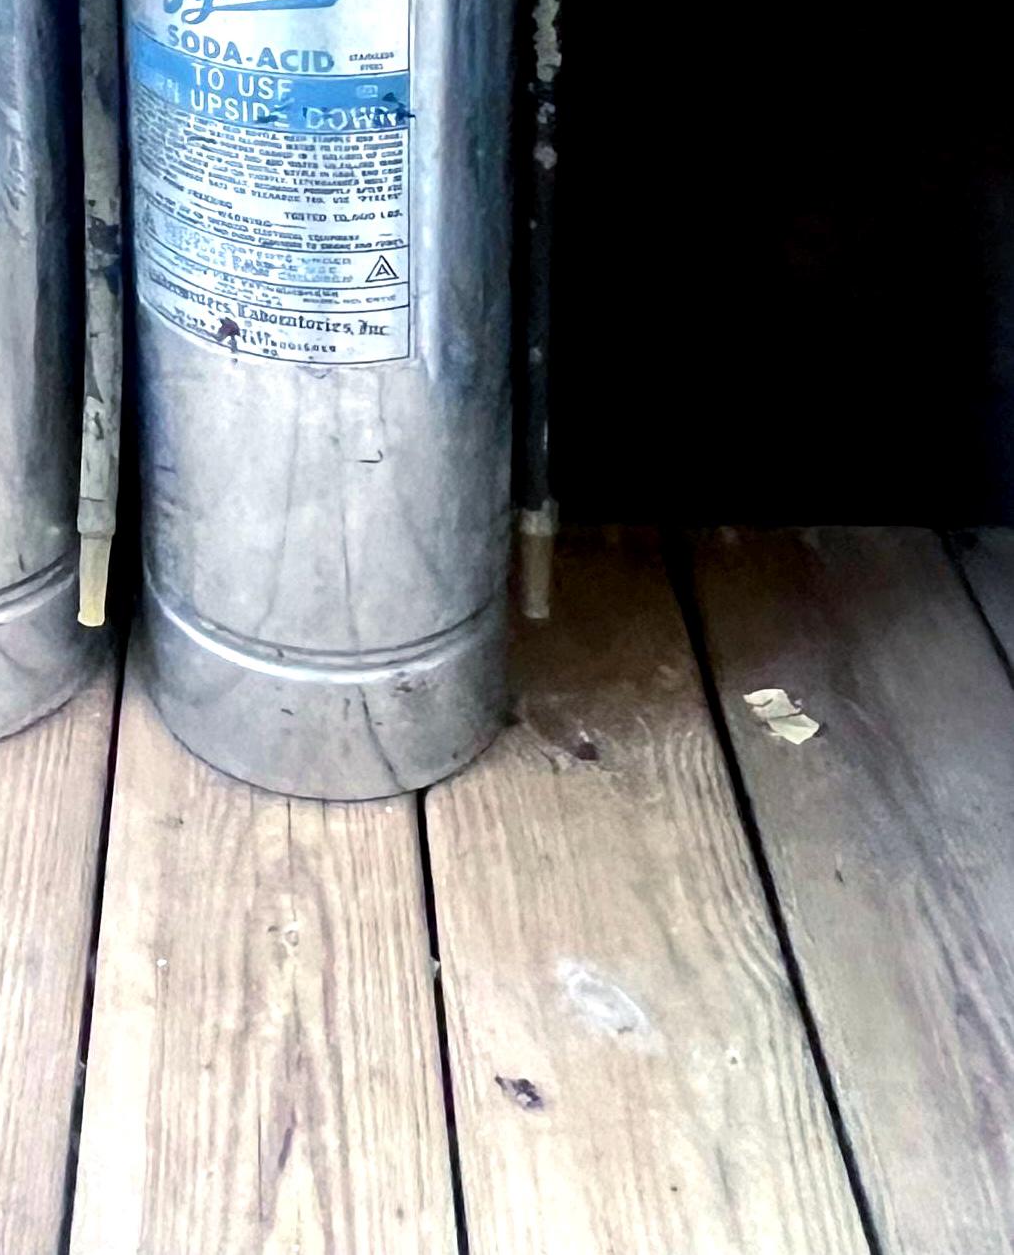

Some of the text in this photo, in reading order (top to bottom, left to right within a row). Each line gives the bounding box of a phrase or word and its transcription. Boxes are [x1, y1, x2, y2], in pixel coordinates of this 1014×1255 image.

[166, 24, 336, 73] SODA-ACID
[190, 62, 225, 91] TO
[238, 74, 294, 102] USE
